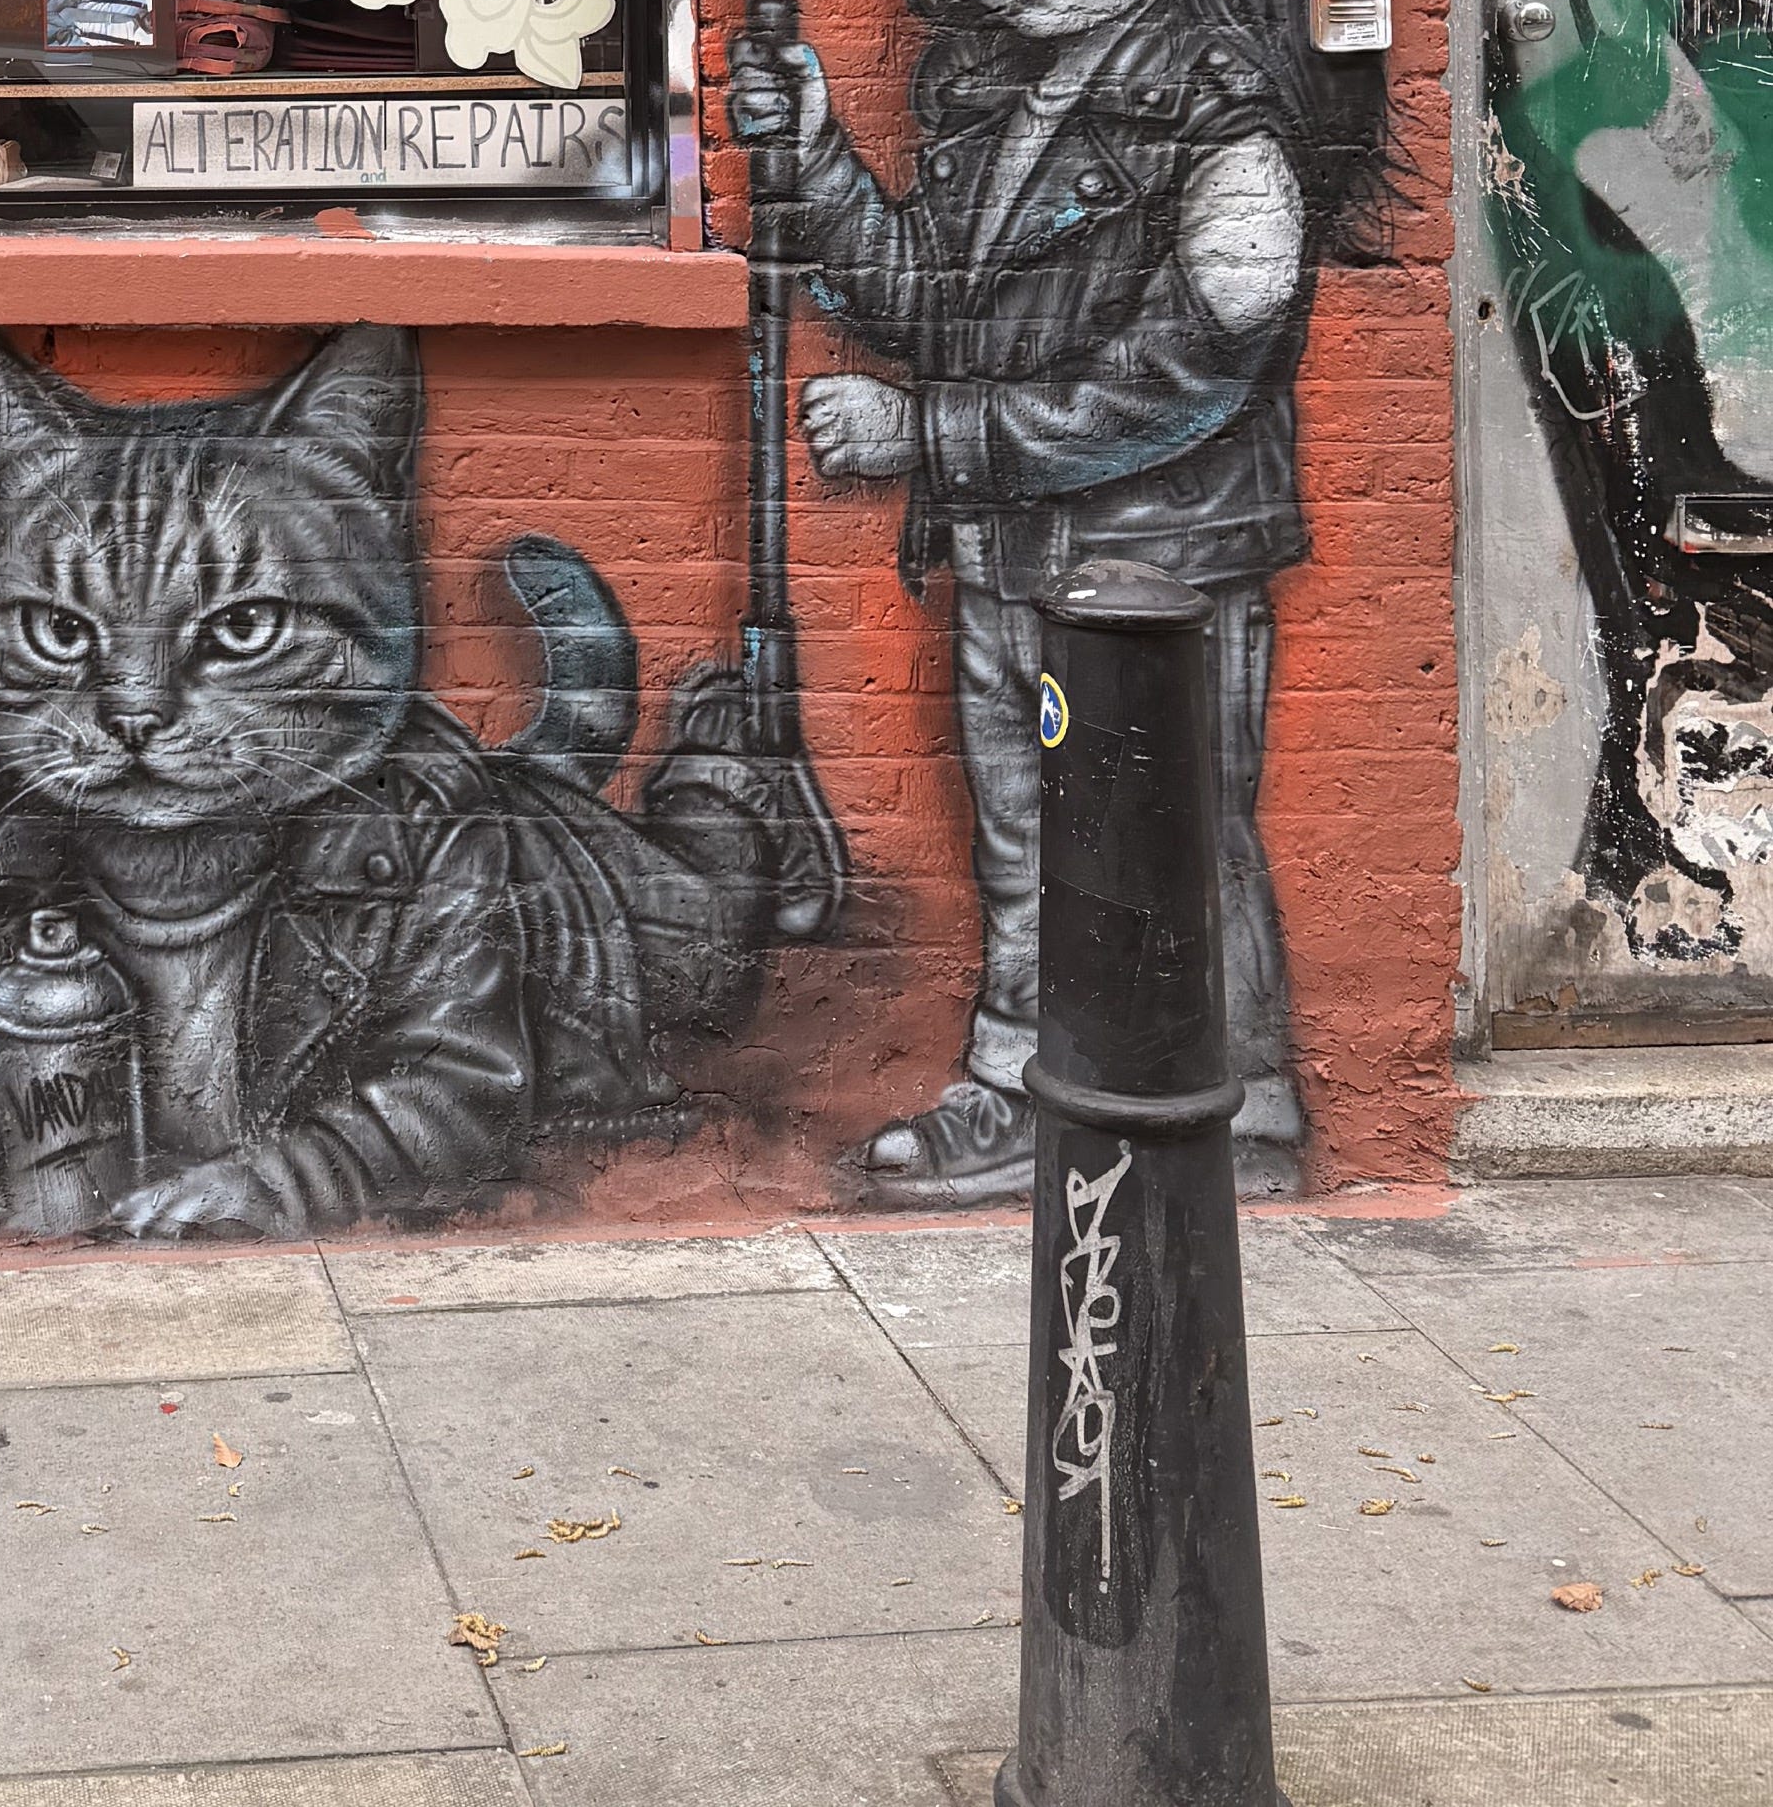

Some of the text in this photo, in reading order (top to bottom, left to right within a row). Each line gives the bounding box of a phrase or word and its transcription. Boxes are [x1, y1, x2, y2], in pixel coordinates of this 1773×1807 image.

[142, 101, 625, 174] ALTERATION REPAIRS
[360, 167, 387, 184] and
